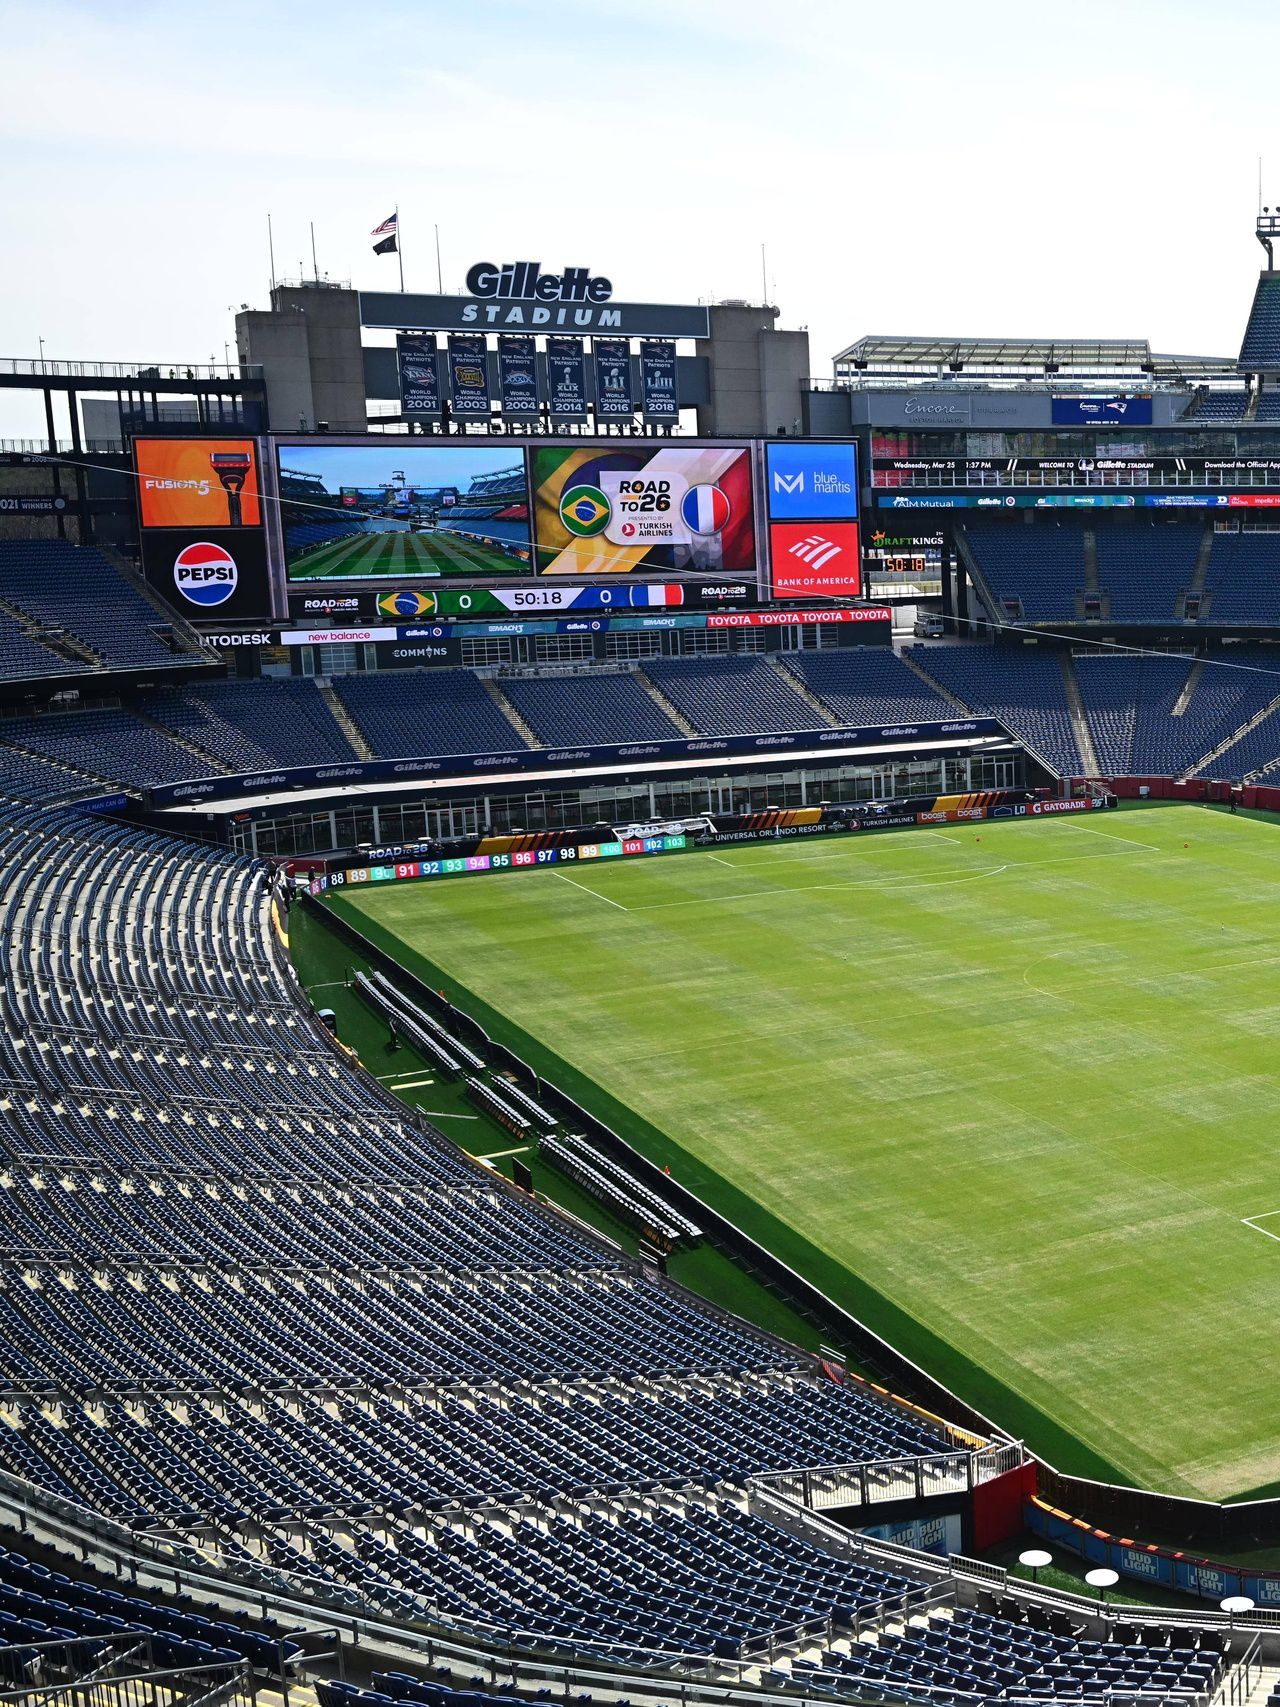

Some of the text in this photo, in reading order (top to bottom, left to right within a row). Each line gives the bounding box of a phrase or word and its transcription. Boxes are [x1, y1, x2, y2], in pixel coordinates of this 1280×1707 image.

[466, 261, 613, 303] Gillette
[461, 305, 622, 327] STADIUM
[407, 400, 436, 408] 2001
[456, 401, 487, 409] 2003
[506, 402, 536, 410] 2004
[905, 397, 968, 414] Encore
[814, 472, 837, 483] blue
[620, 480, 670, 493] ROAD
[814, 482, 850, 493] mantis
[620, 502, 639, 512] TO
[874, 536, 944, 547] DRAFTKINGS
[887, 558, 924, 571] 50:18
[178, 567, 234, 582] PEPSI
[305, 598, 358, 608] ROAD 26
[459, 590, 612, 609] 0 50:18 0
[708, 610, 888, 626] TOYOTA TOYOTA TOYOTA TOYOTA
[330, 631, 370, 640] balance
[881, 727, 918, 736] Gillette
[941, 723, 976, 732] Gillette
[755, 736, 795, 745] Gillette
[820, 732, 857, 740] Gillette
[618, 746, 660, 756] Gillette
[687, 741, 727, 750] Gillette
[474, 756, 518, 766] Gillette
[547, 751, 590, 761] Gillette
[316, 767, 363, 778] Gillette
[394, 762, 440, 772] Gillette
[243, 775, 286, 786] Gillette
[174, 785, 214, 796] Gillette
[1044, 801, 1086, 811] GATORADE
[922, 811, 946, 820] boost
[957, 808, 983, 816] boost
[715, 832, 758, 842] UNIVERSAL
[760, 828, 797, 838] ORLANDO
[798, 824, 826, 833] RESORT
[369, 847, 402, 860] ROAD
[413, 844, 428, 853] 26
[331, 873, 344, 885] 88
[351, 870, 367, 881] 89
[400, 866, 414, 876] 91
[424, 863, 439, 874] 92
[447, 860, 462, 871] 93
[470, 857, 485, 868] 94
[493, 855, 508, 866] 95
[516, 853, 531, 864] 96
[538, 850, 553, 862] 97
[561, 848, 576, 859] 98
[582, 846, 597, 857] 99
[604, 844, 619, 853] 100
[625, 843, 641, 851] 101
[646, 840, 662, 848] 102
[667, 838, 682, 846] 103
[920, 1519, 942, 1537] BUD
[1128, 1550, 1151, 1565] BUD
[1124, 1558, 1156, 1575] LIGHT
